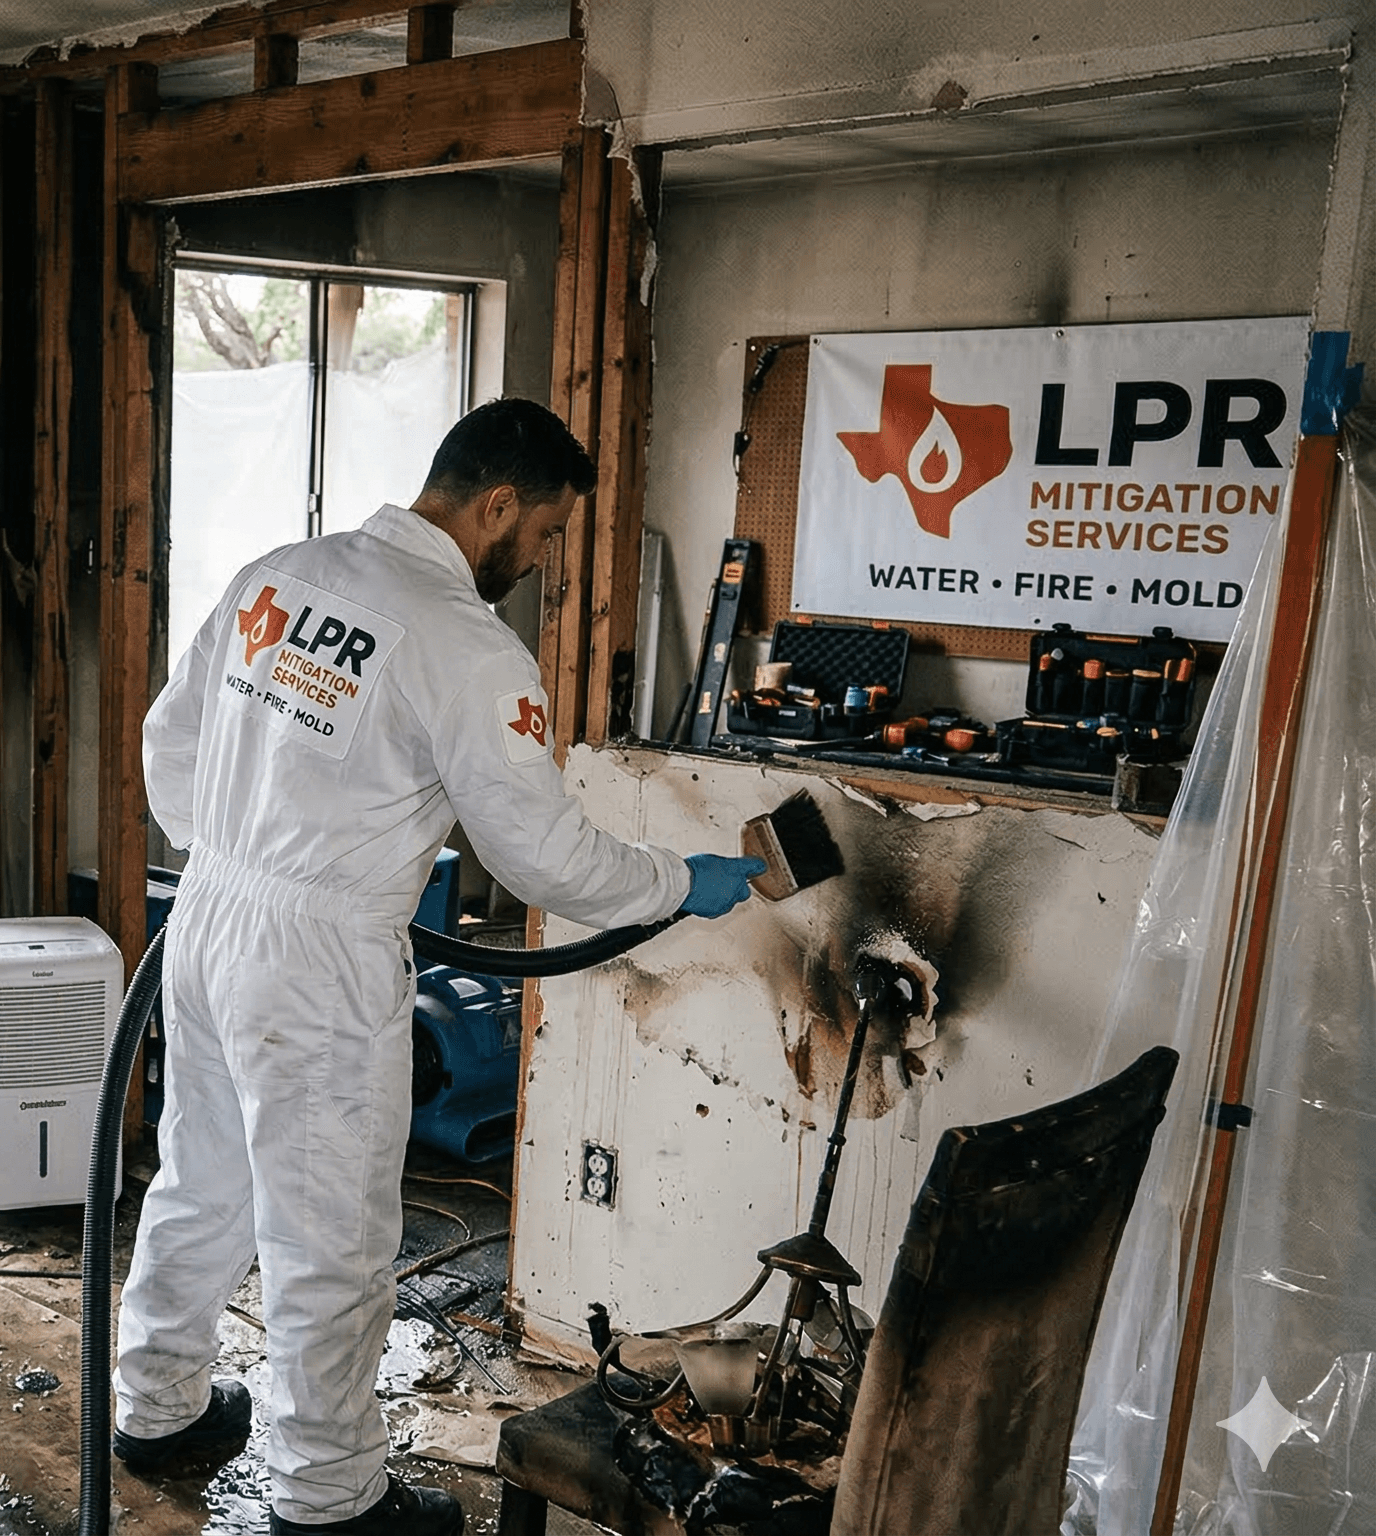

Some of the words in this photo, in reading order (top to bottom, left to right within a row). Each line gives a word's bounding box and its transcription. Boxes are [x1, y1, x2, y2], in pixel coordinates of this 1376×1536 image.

[1034, 378, 1288, 469] LPR
[1030, 482, 1280, 516] MITIGATION
[1026, 519, 1230, 554] SERVICES
[869, 563, 980, 594] WATER
[1015, 572, 1093, 602] FIRE
[1131, 579, 1244, 609] MOLD
[287, 605, 376, 678] LPR
[226, 673, 254, 698] WATER
[263, 691, 288, 714] FIRE
[293, 708, 335, 737] MOLD
